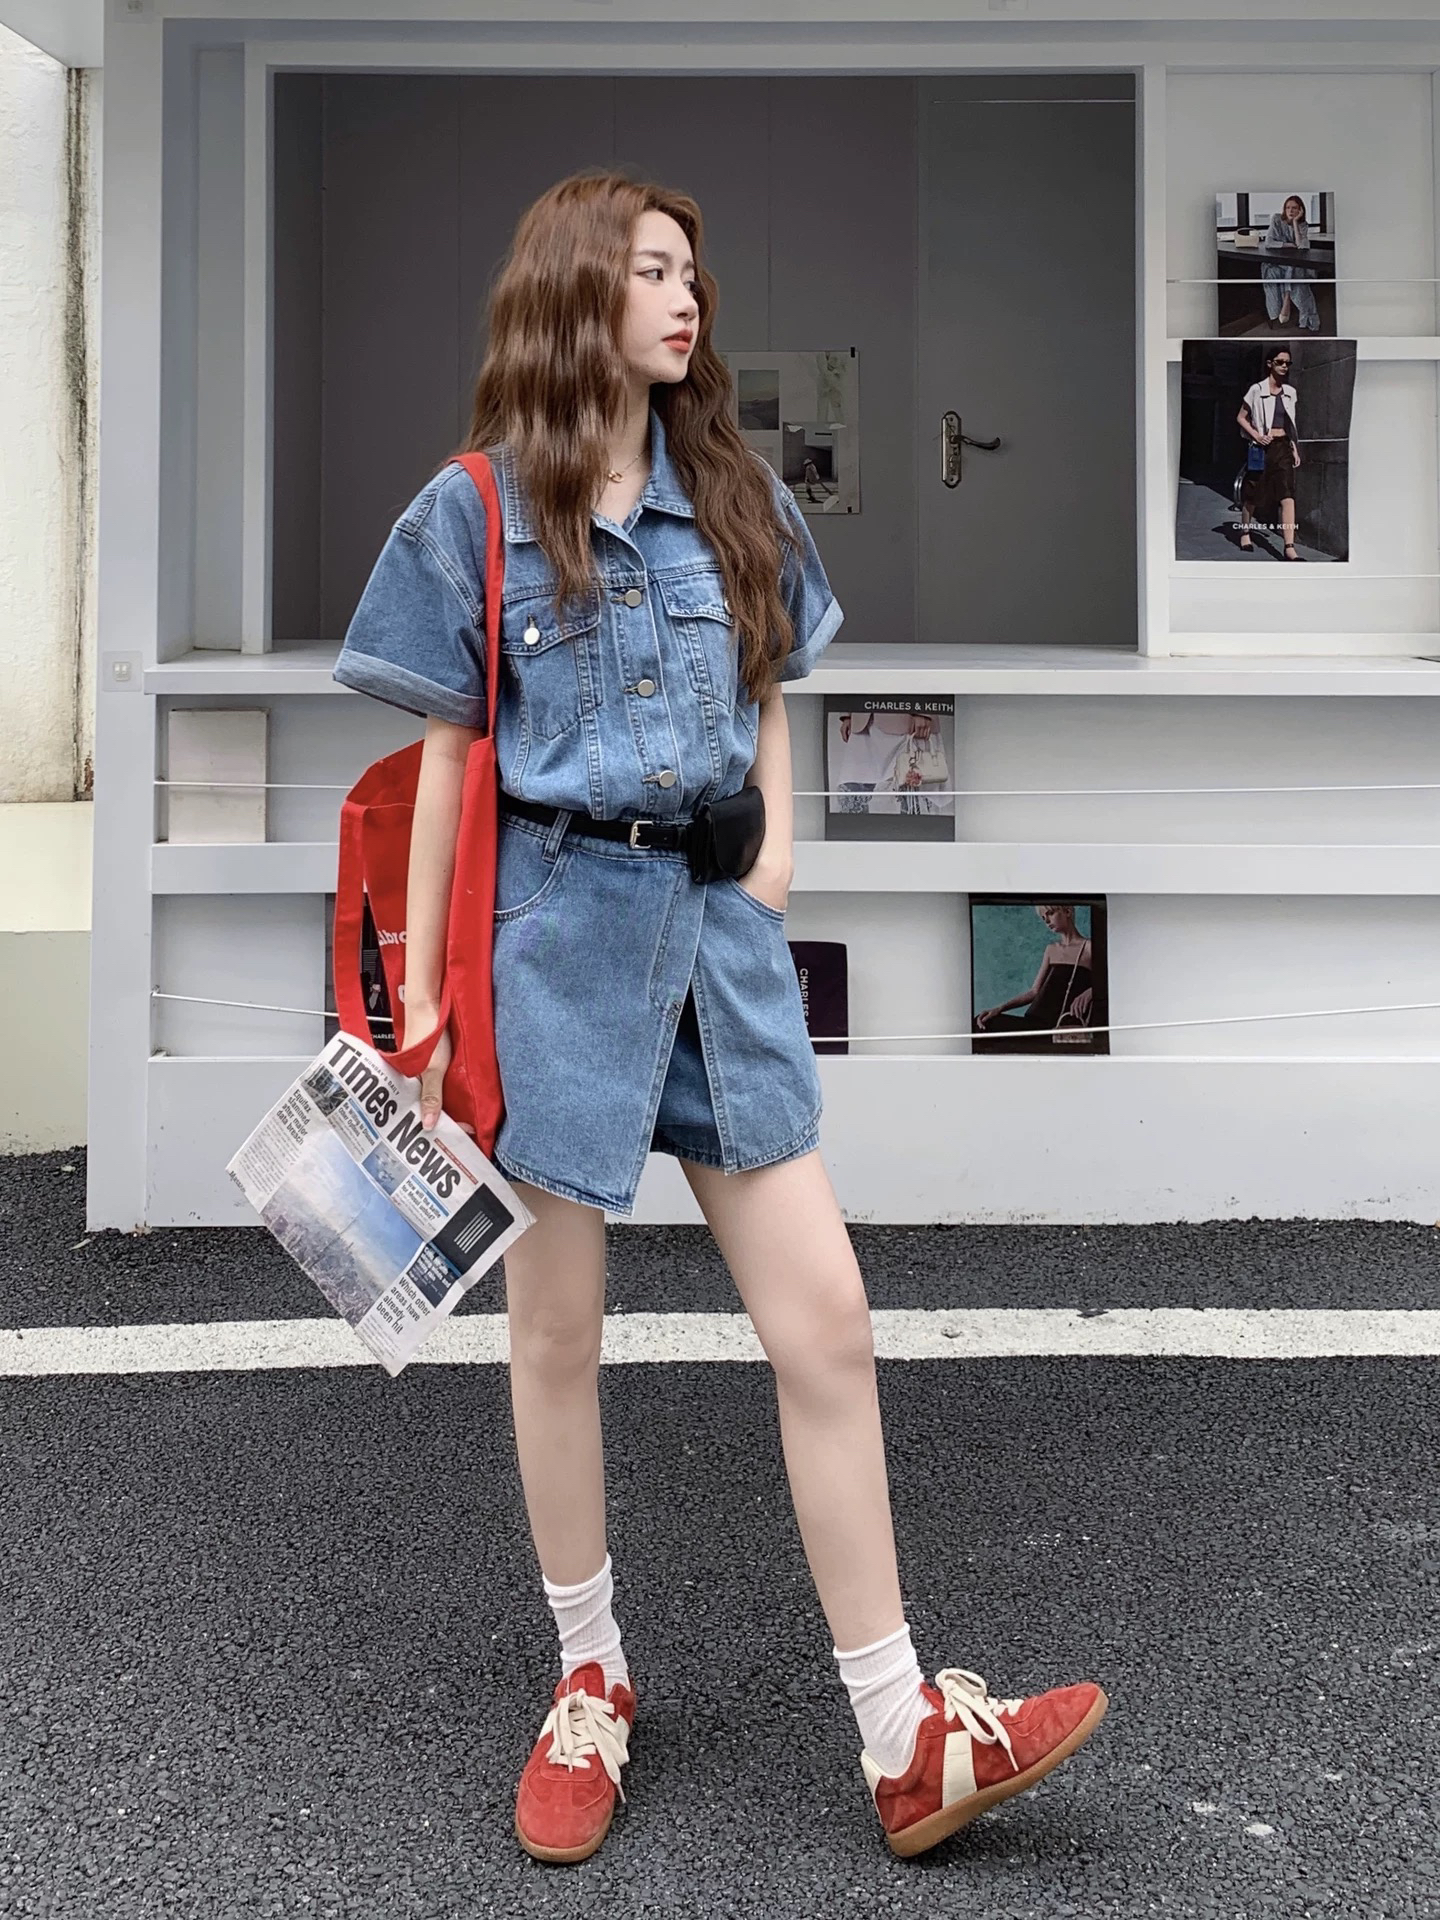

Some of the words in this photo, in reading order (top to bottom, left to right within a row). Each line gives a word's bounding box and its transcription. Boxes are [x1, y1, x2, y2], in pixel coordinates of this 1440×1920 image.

[864, 701, 911, 711] CHARLES
[914, 703, 921, 711] &
[924, 702, 954, 712] KEITH
[288, 1097, 311, 1125] slammed
[293, 1089, 312, 1114] Equifax
[276, 1110, 288, 1125] data
[286, 1122, 303, 1145] breach
[282, 1103, 295, 1119] after
[292, 1118, 308, 1136] major
[329, 1039, 398, 1128] Times
[386, 1110, 461, 1199] News
[383, 1295, 405, 1322] already
[390, 1286, 408, 1307] areas
[406, 1303, 420, 1322] have
[398, 1276, 417, 1300] Which
[415, 1298, 431, 1316] other
[376, 1301, 393, 1323] been
[391, 1319, 404, 1335] hit
